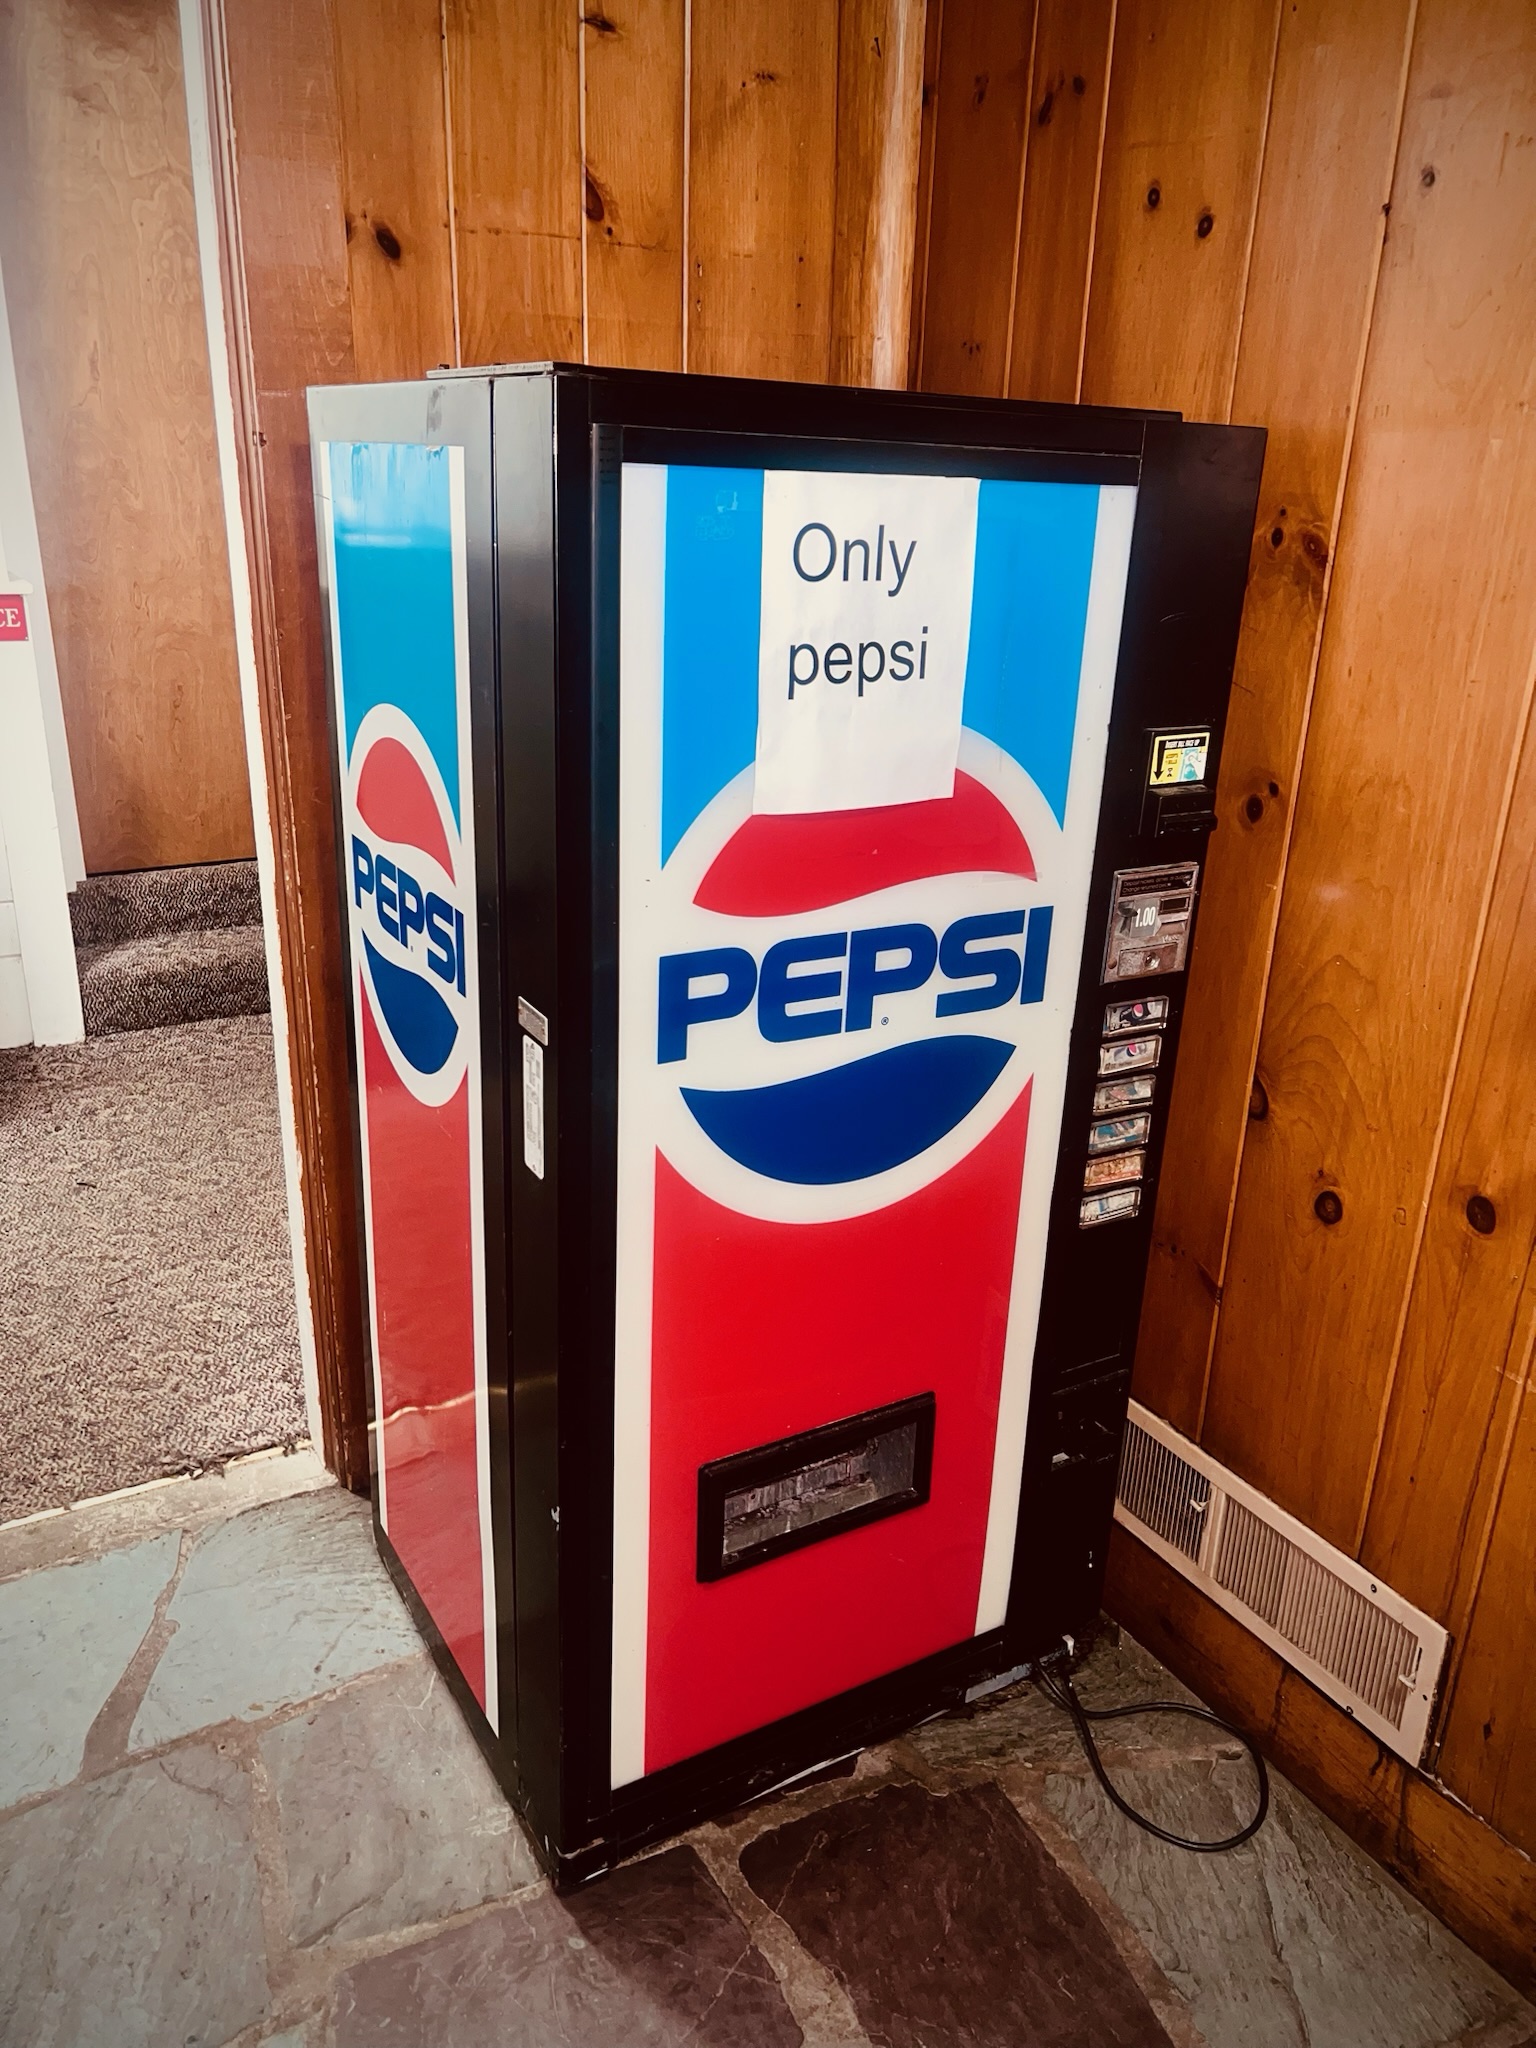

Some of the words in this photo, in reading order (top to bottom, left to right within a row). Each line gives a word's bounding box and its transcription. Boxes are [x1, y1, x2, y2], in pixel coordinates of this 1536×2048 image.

[793, 522, 917, 597] Only
[788, 626, 928, 700] pepsi
[352, 833, 467, 998] PEPSI
[1135, 906, 1156, 928] 1.00
[657, 905, 1054, 1065] PEPSI
